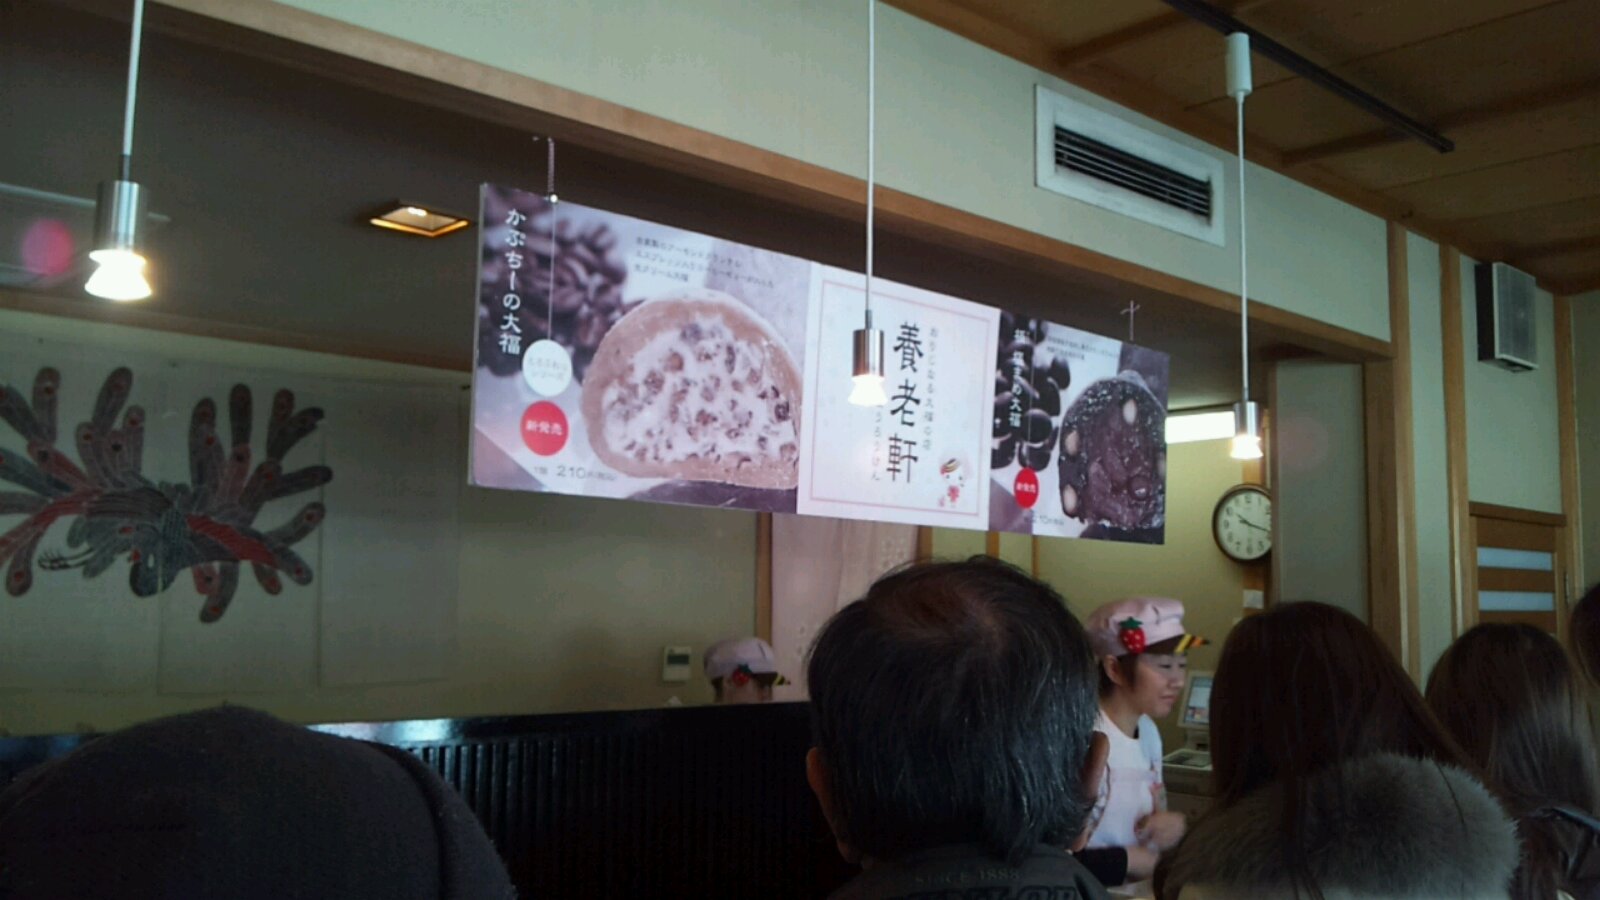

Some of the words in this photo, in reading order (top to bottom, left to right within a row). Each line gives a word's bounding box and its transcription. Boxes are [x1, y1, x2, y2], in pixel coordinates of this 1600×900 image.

[499, 208, 527, 355] かぷちーの大福
[525, 419, 562, 435] 新発売
[885, 319, 924, 483] 養老軒
